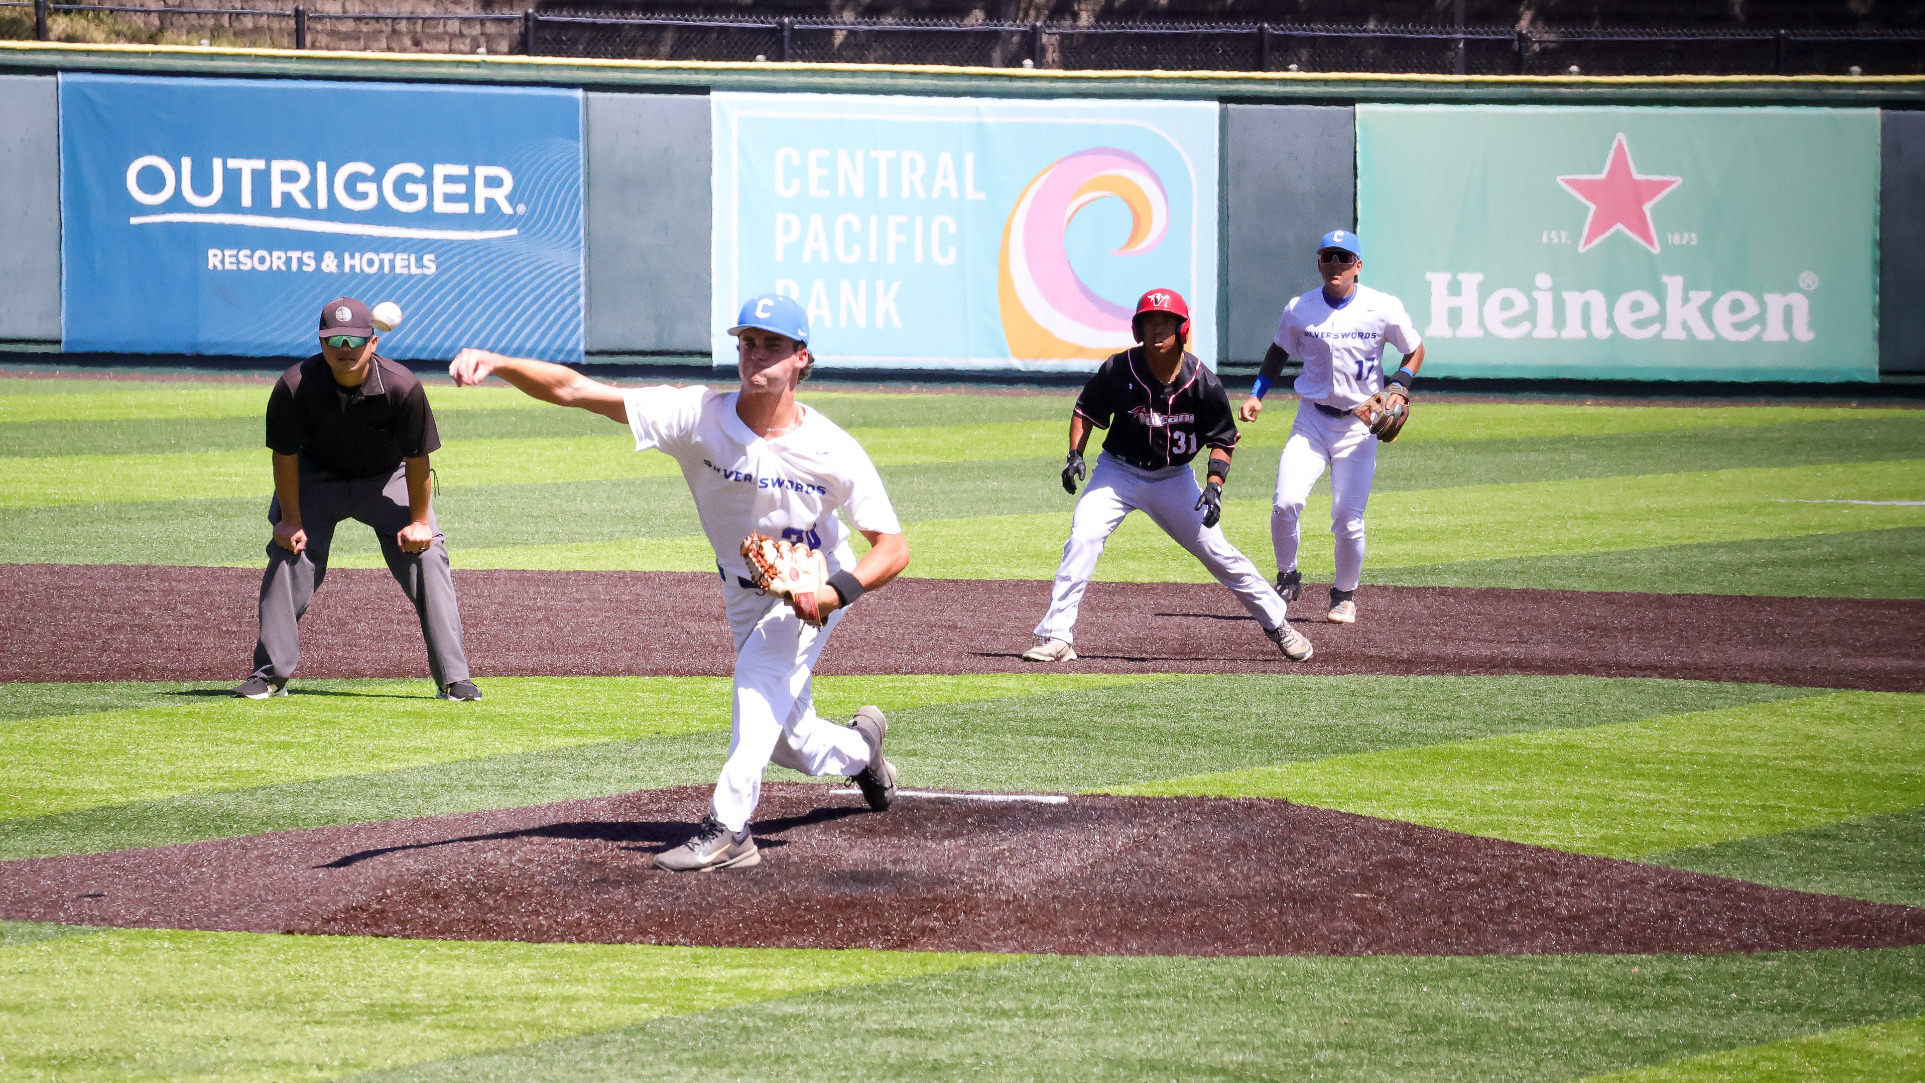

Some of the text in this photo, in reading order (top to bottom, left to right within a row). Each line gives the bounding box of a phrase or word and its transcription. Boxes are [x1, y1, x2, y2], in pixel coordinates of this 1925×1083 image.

[126, 154, 515, 215] OUTRIGGER
[773, 146, 987, 200] CENTRAL
[774, 212, 959, 266] PACIFIC
[1332, 229, 1345, 243] C
[1667, 231, 1699, 246] 1873
[207, 248, 437, 275] RESORTS & HOTELS
[754, 298, 774, 319] C
[1424, 272, 1816, 343] Heineken
[1354, 357, 1376, 381] 17
[1172, 430, 1198, 455] 31
